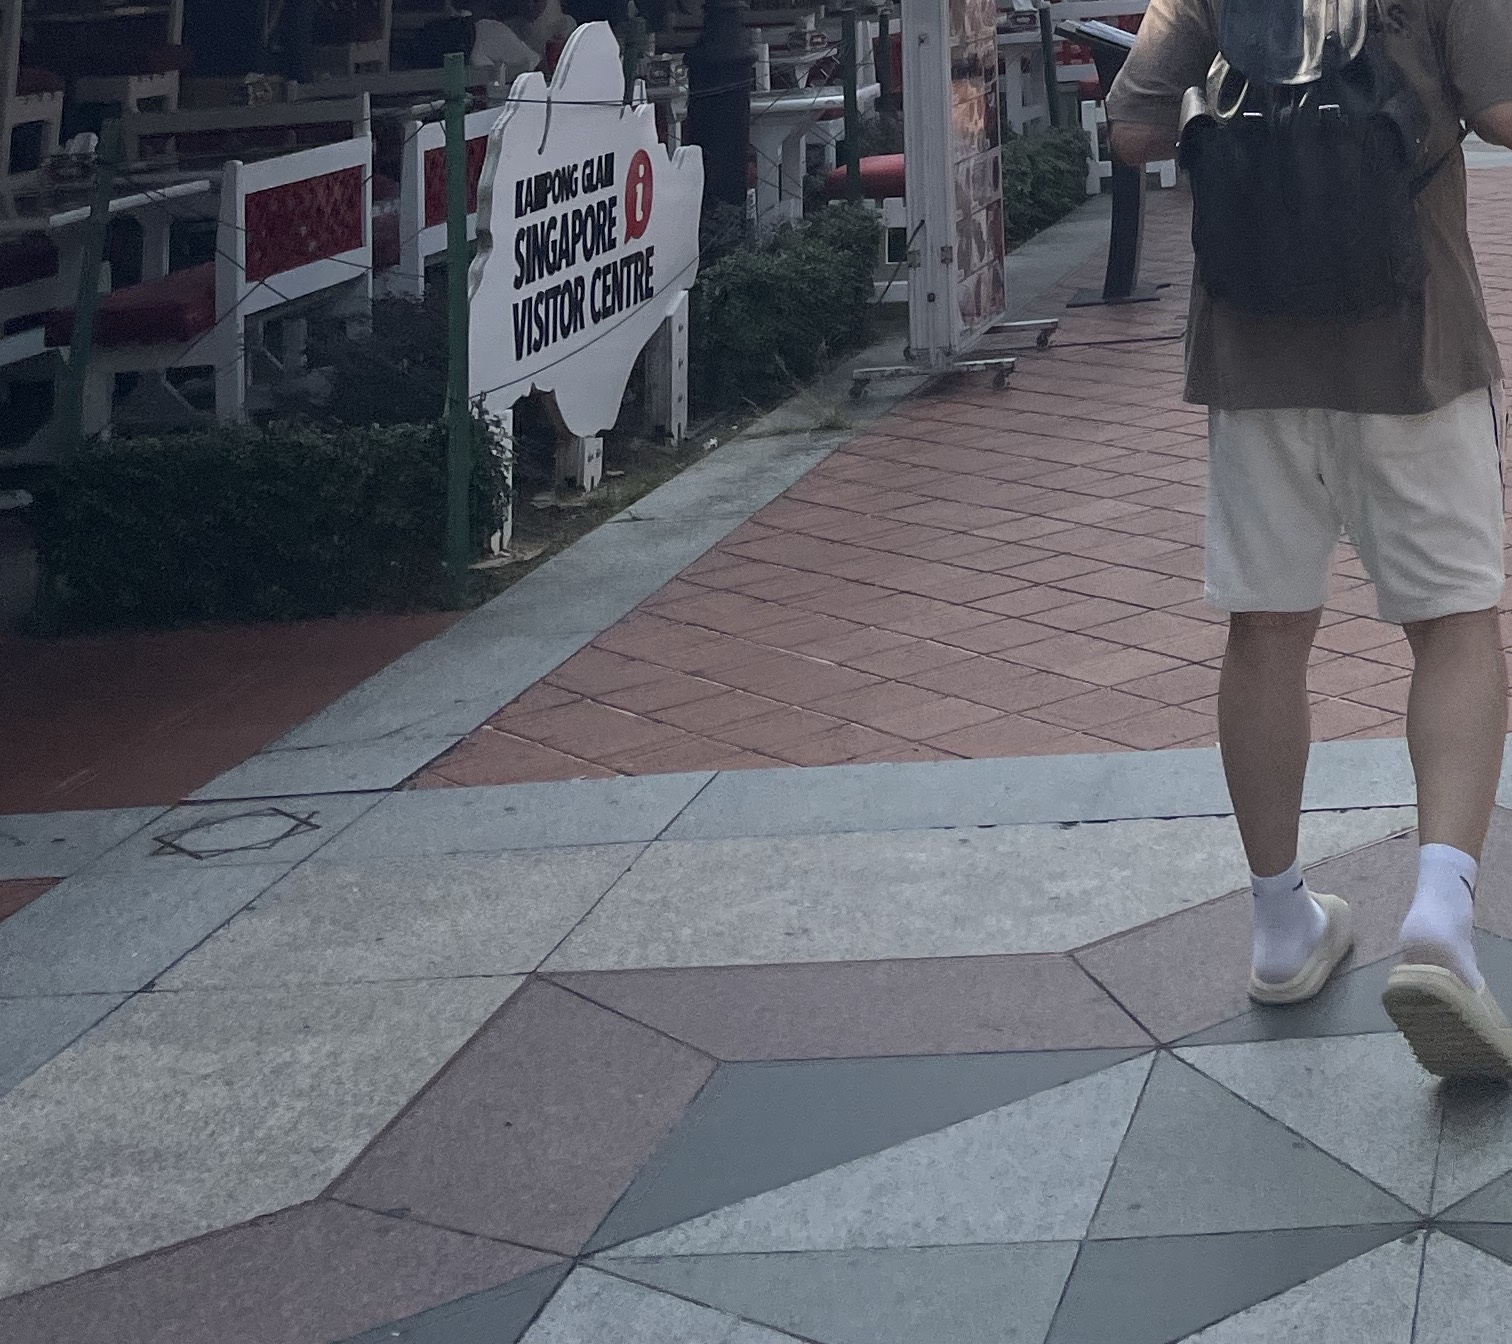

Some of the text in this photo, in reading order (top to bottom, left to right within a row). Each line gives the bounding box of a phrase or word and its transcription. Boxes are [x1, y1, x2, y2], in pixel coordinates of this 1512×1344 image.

[514, 151, 616, 219] KAMPONG GLAM
[513, 194, 618, 291] SINGAPORE
[512, 245, 655, 362] VISITOR CENTRE
